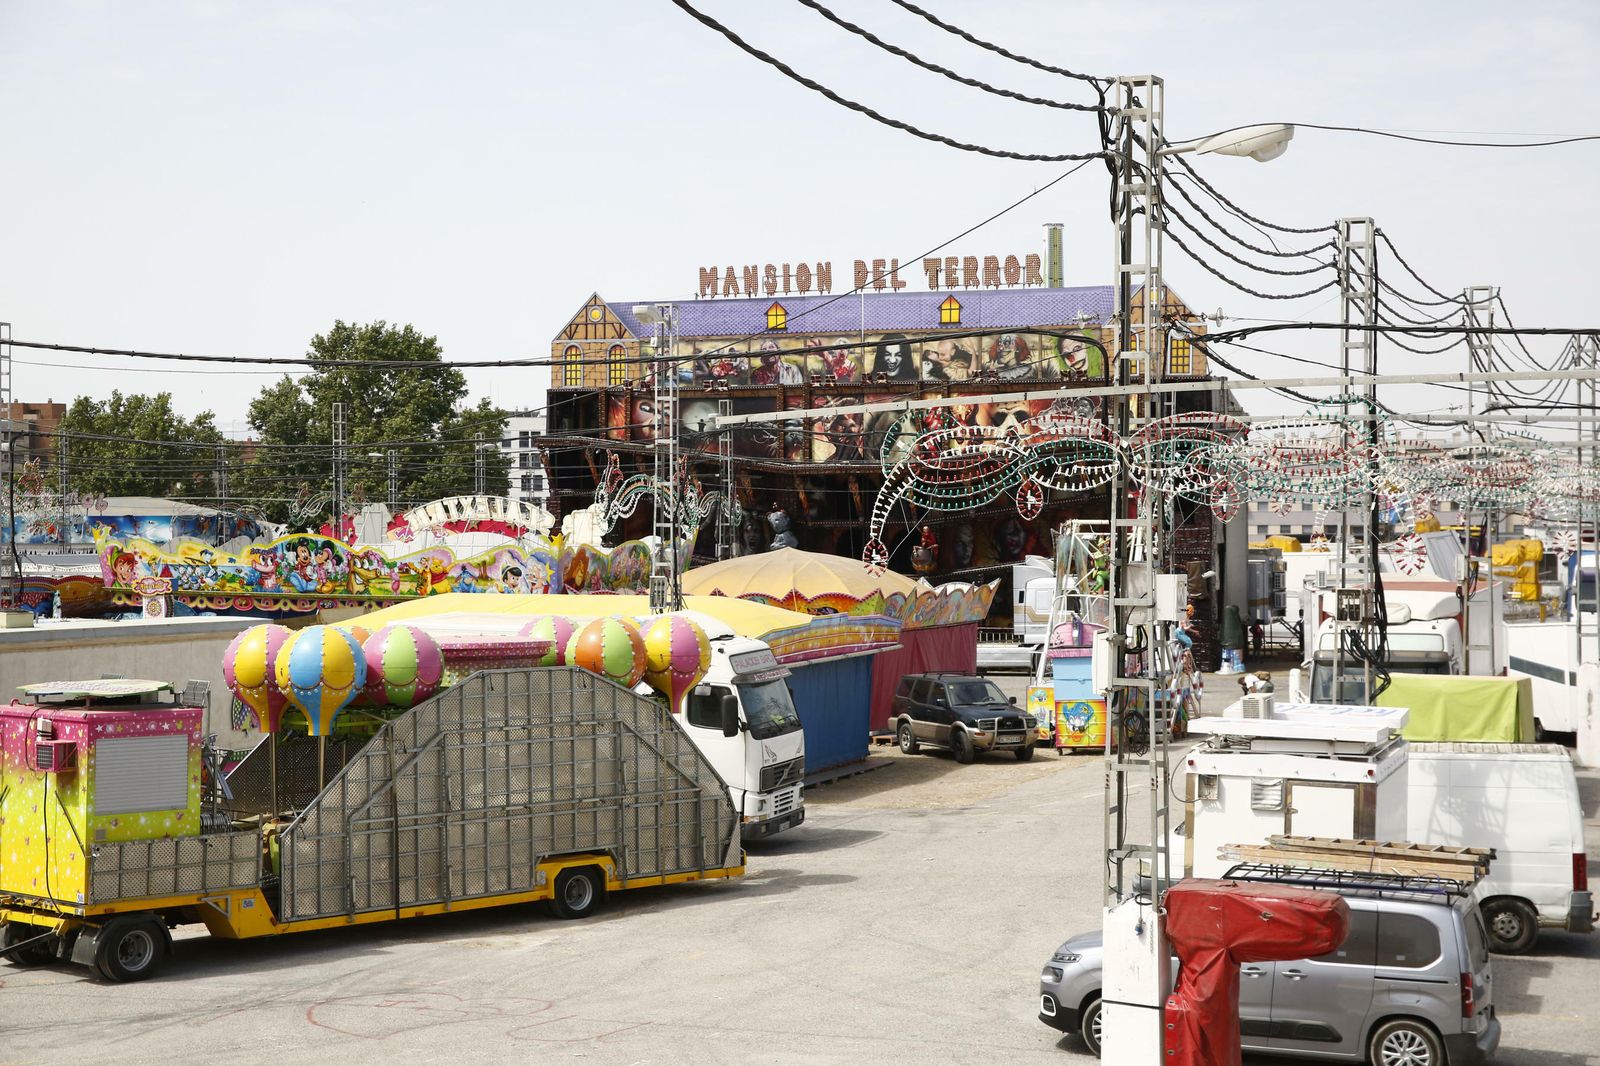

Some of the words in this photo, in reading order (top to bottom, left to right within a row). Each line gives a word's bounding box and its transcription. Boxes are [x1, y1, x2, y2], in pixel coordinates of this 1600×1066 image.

[699, 261, 832, 298] MANSION
[854, 258, 907, 292] DEL
[923, 253, 1044, 290] TERROR
